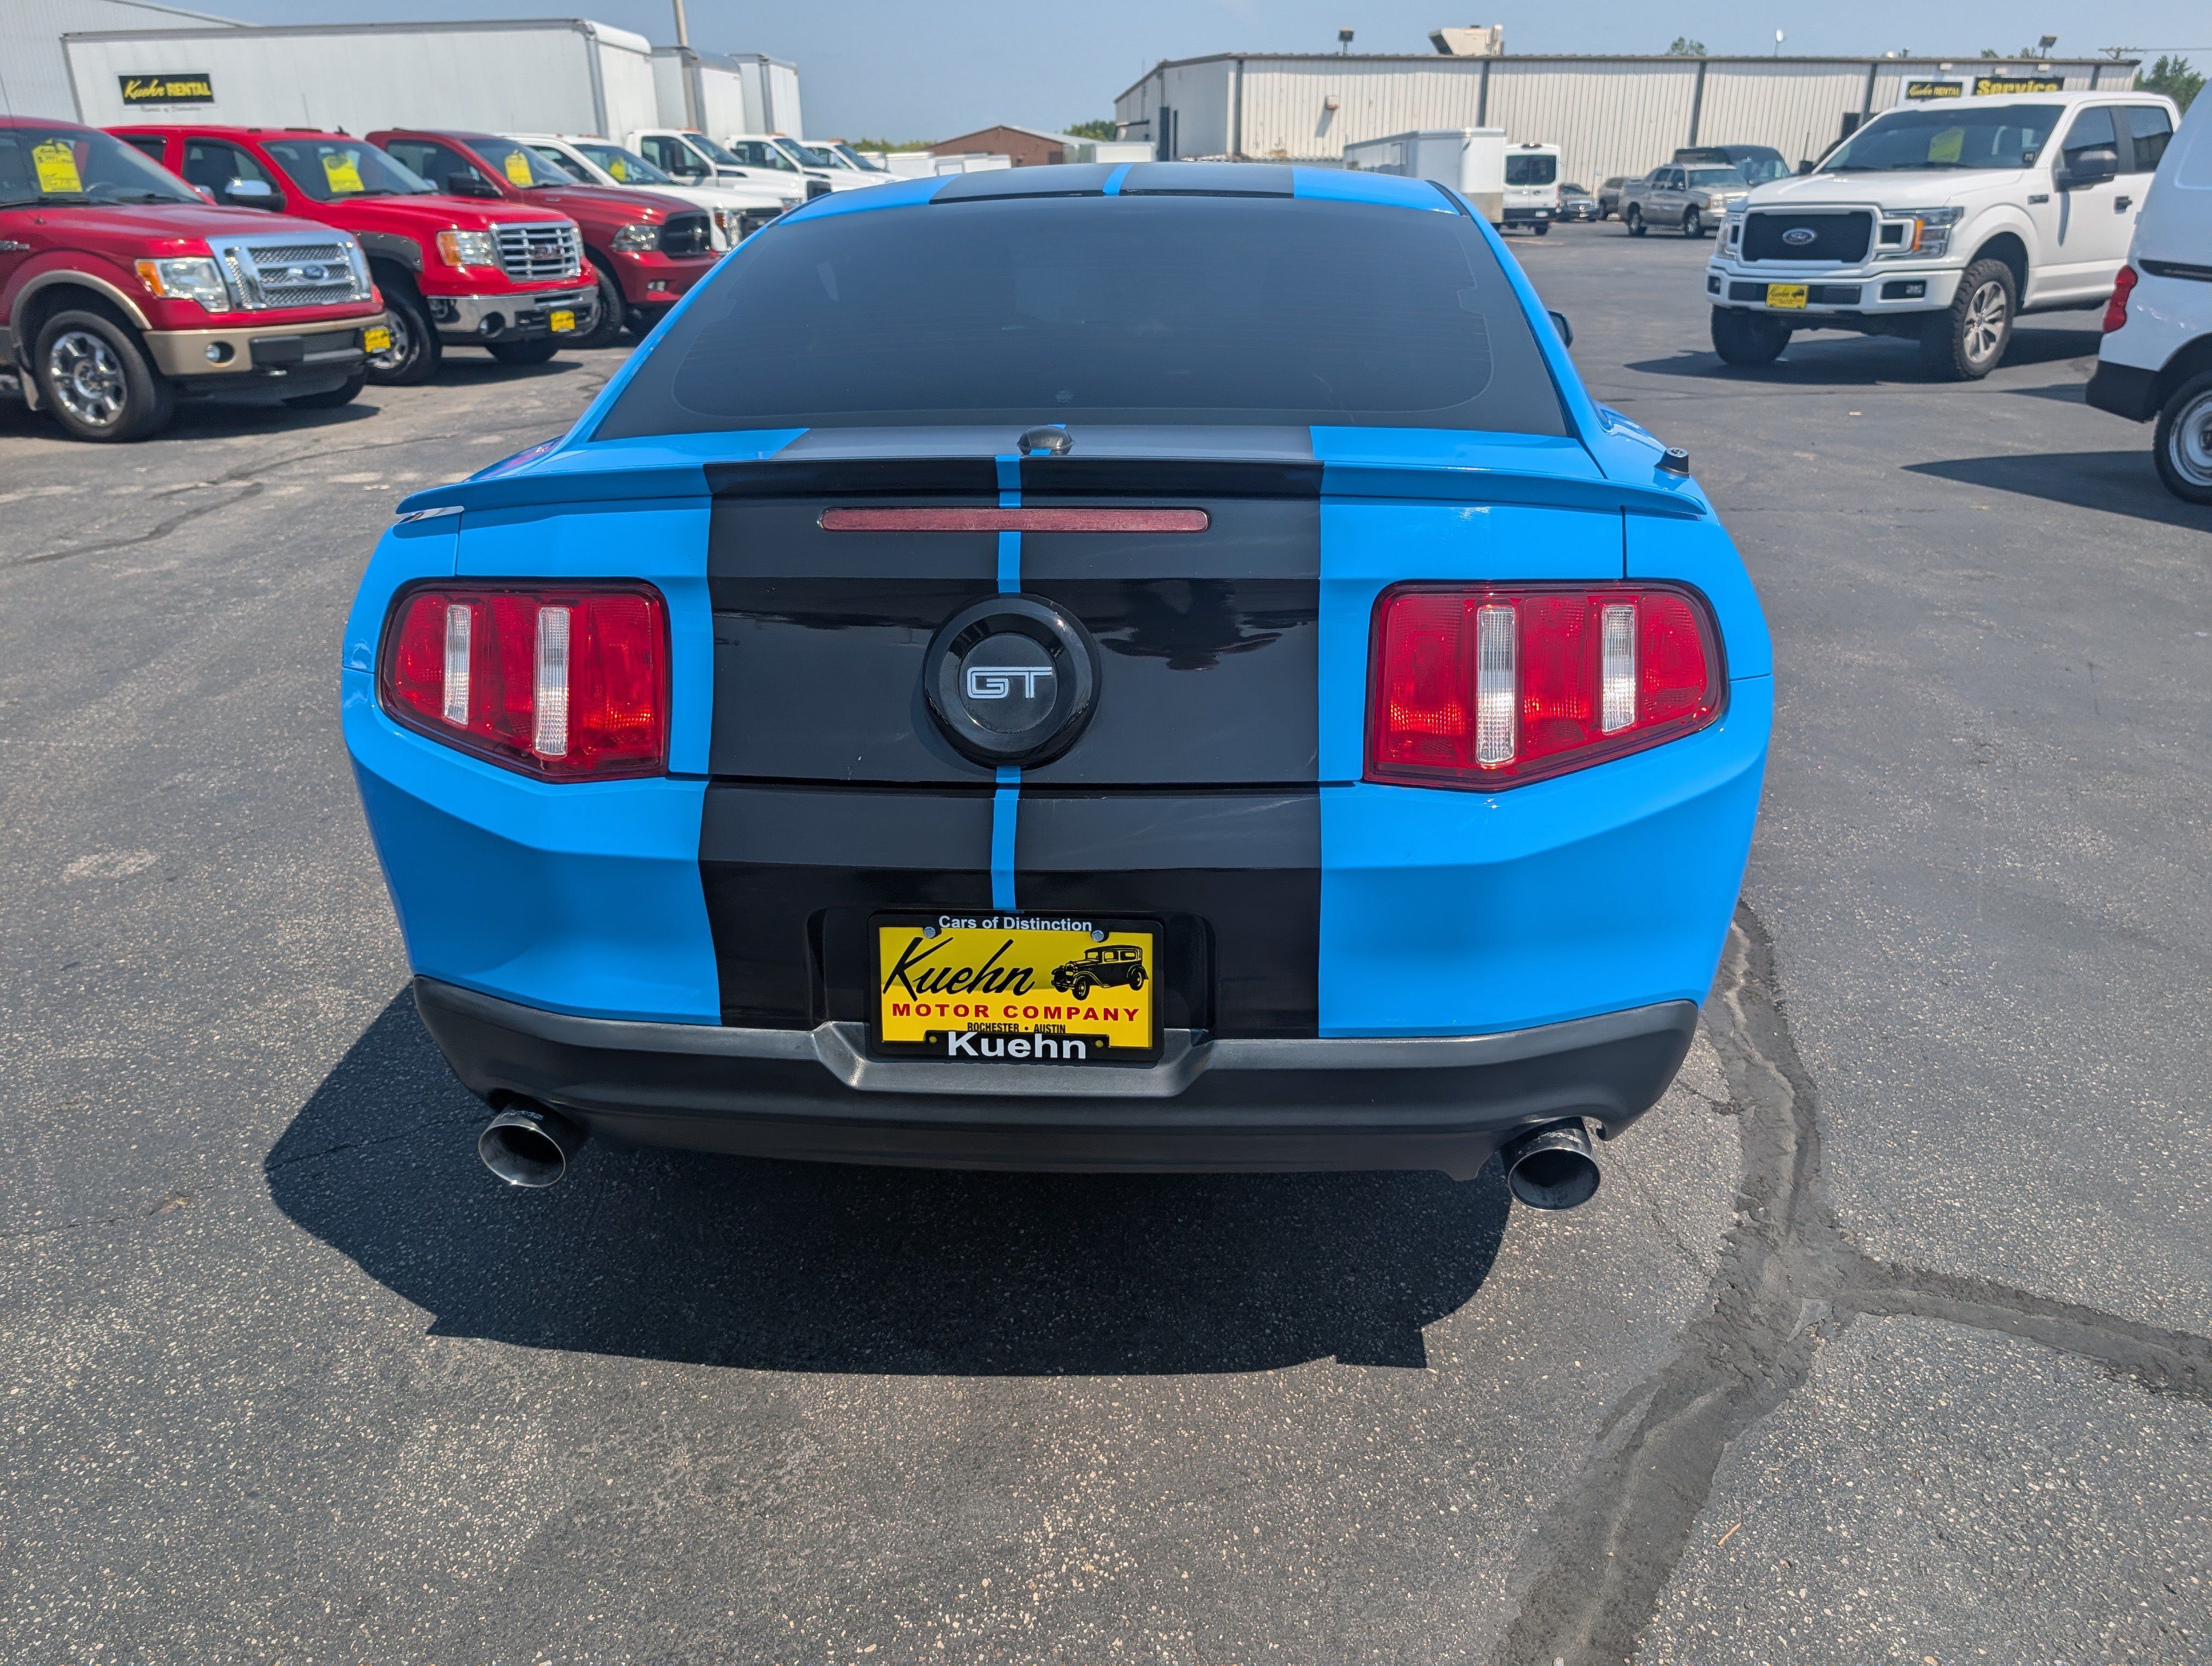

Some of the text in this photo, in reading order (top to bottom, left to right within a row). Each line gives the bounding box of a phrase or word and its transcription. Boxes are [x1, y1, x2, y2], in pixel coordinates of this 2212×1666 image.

[124, 79, 212, 100] Kuehn RENTAL
[1933, 87, 1960, 95] RENTAL
[1977, 79, 2059, 95] Service
[967, 667, 1053, 699] GT
[938, 915, 1092, 932] Cars of Distinction
[882, 937, 1036, 1002] Kuehn
[892, 1003, 1140, 1022] MOTOR COMPANY
[967, 1022, 1066, 1034] ROCHESTER AUSTIN
[948, 1031, 1086, 1059] Kuehn
